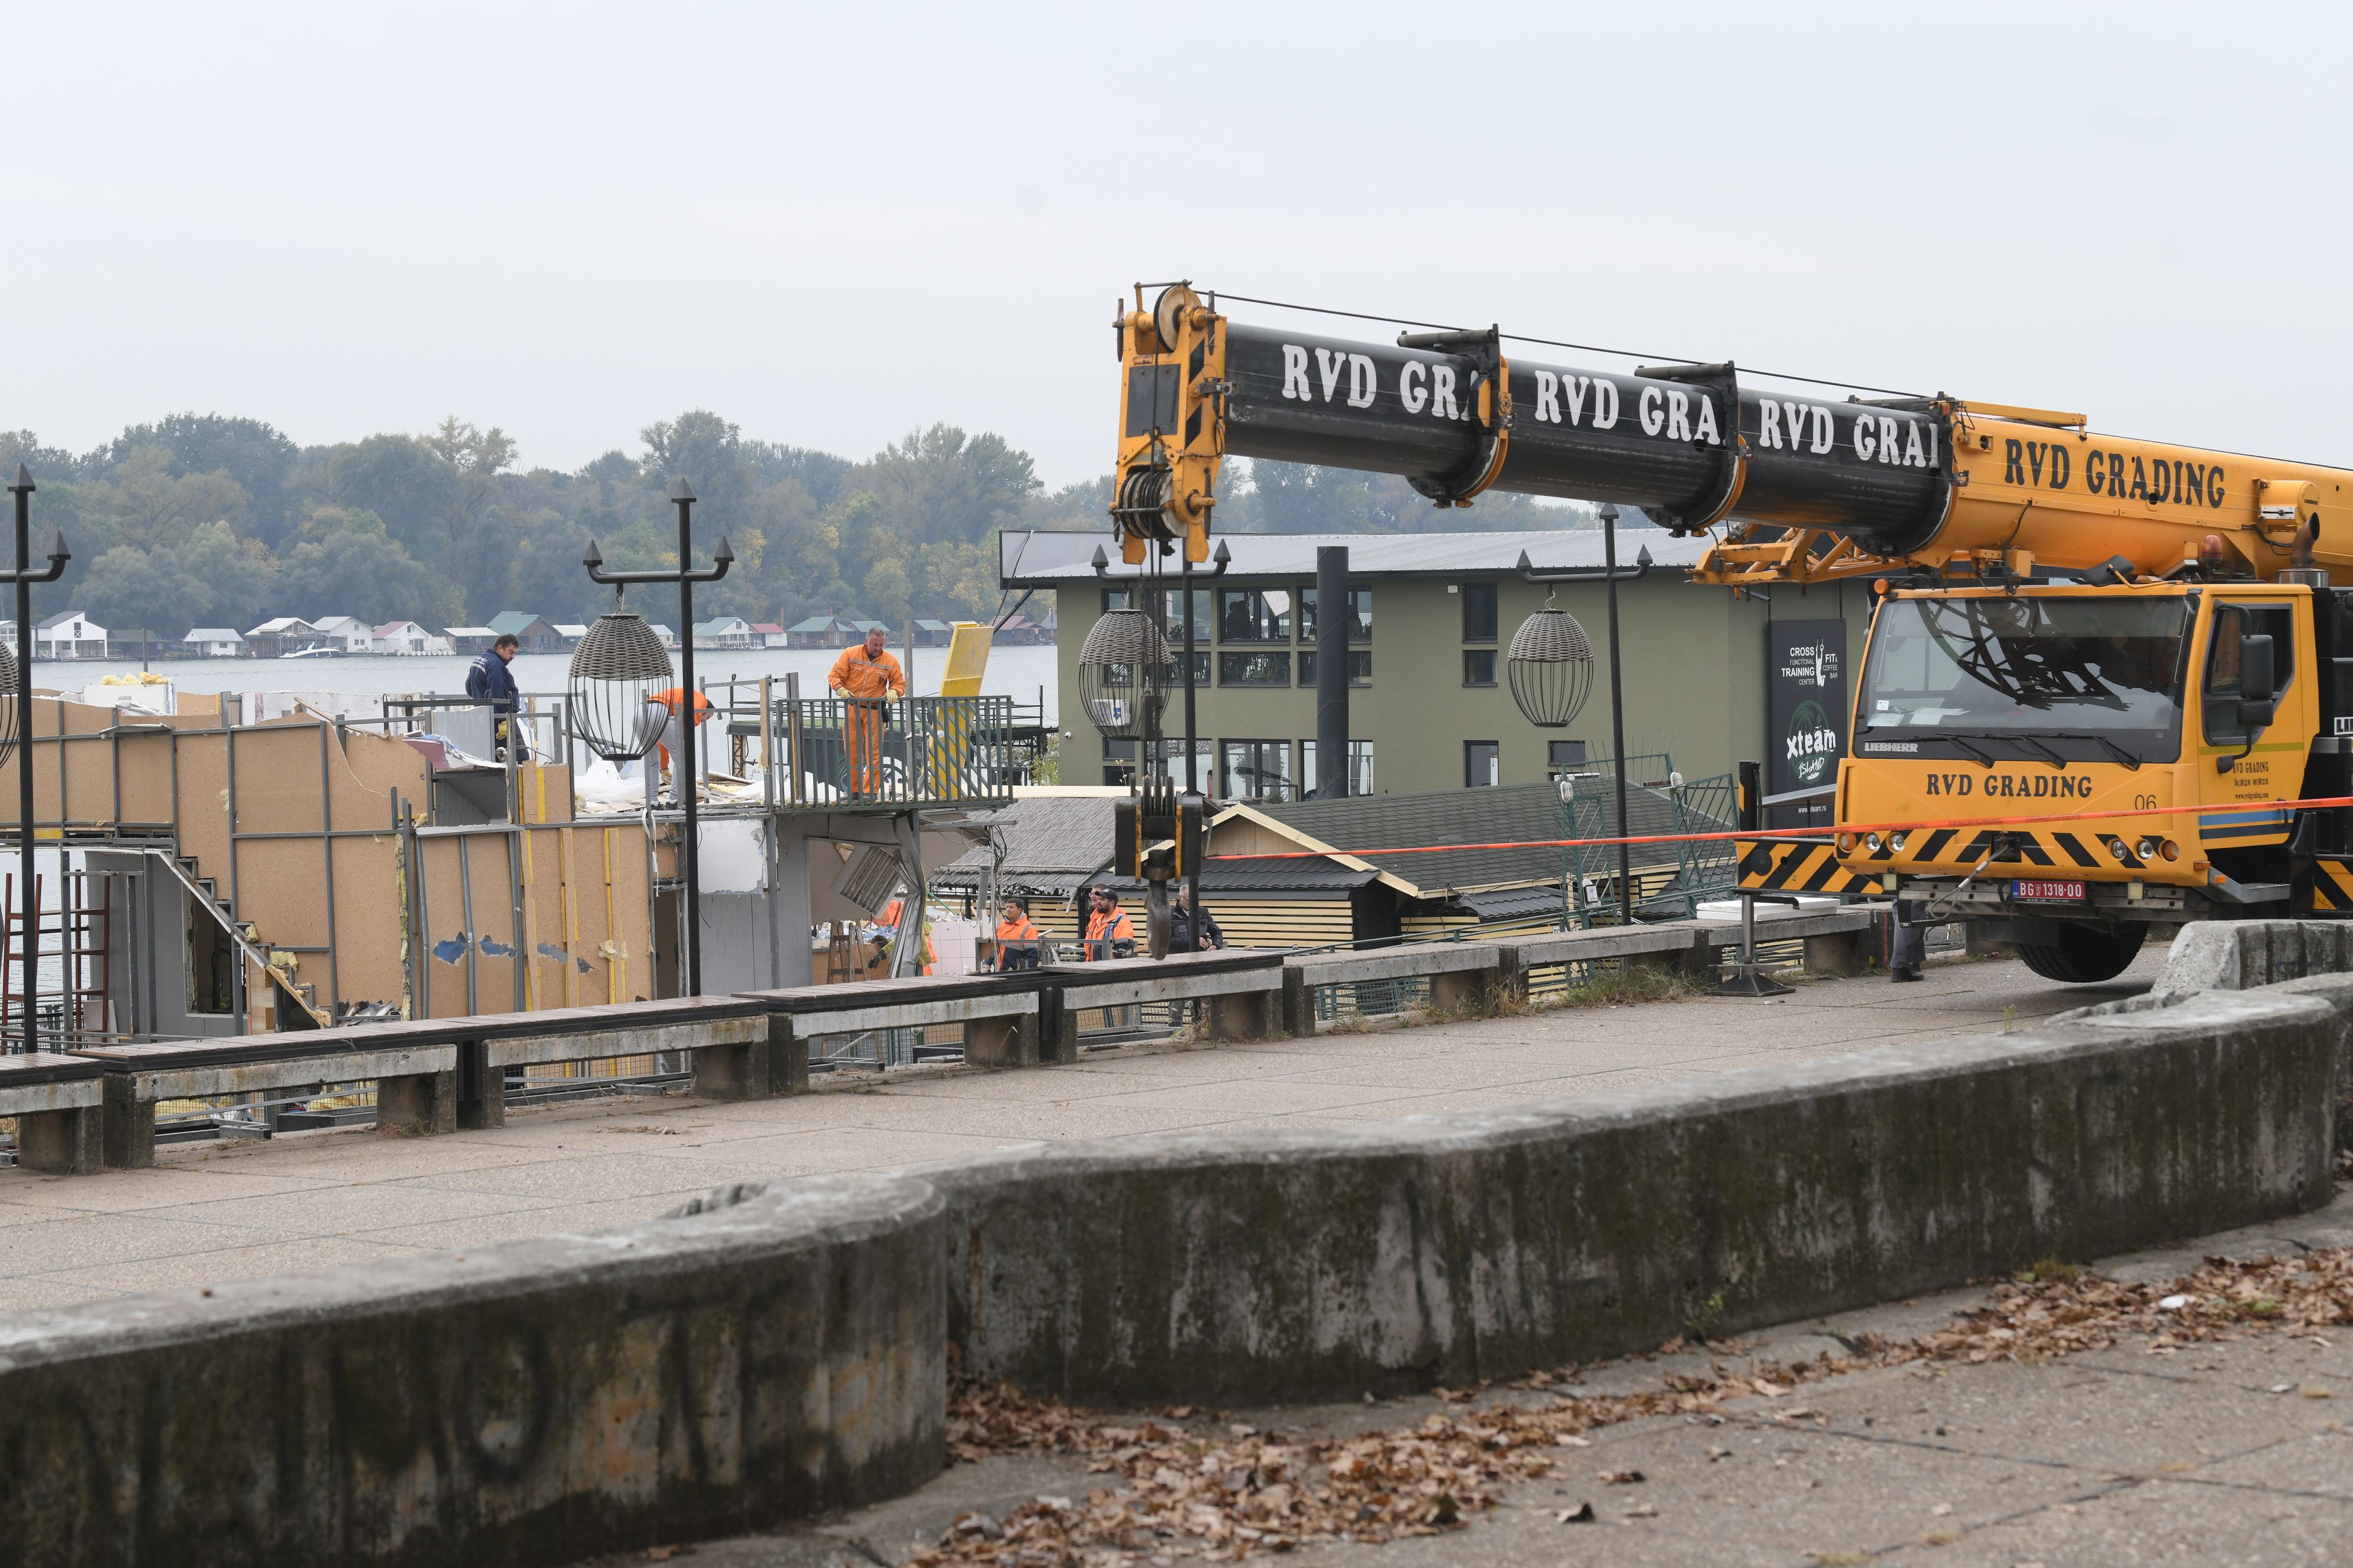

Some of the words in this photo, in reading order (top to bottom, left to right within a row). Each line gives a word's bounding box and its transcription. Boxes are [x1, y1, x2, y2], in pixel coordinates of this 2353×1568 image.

[1282, 344, 1377, 408] RVD
[1535, 370, 1619, 429] RVD
[1639, 386, 1726, 445] GRA
[1759, 399, 1834, 454] RVD
[2005, 439, 2070, 489] RVD
[2086, 449, 2225, 508] GRADING
[1790, 646, 1815, 656] CROSS
[1781, 667, 1815, 677] TRAINING
[1787, 727, 1836, 760] xteam
[1864, 742, 1918, 752] LIEBHERR
[1798, 757, 1825, 779] ISLAND
[2245, 762, 2269, 773] GRADING
[1927, 773, 1972, 795] RVD
[1984, 775, 2092, 798] GRADING
[2135, 795, 2156, 810] 06
[2020, 883, 2034, 896] BG
